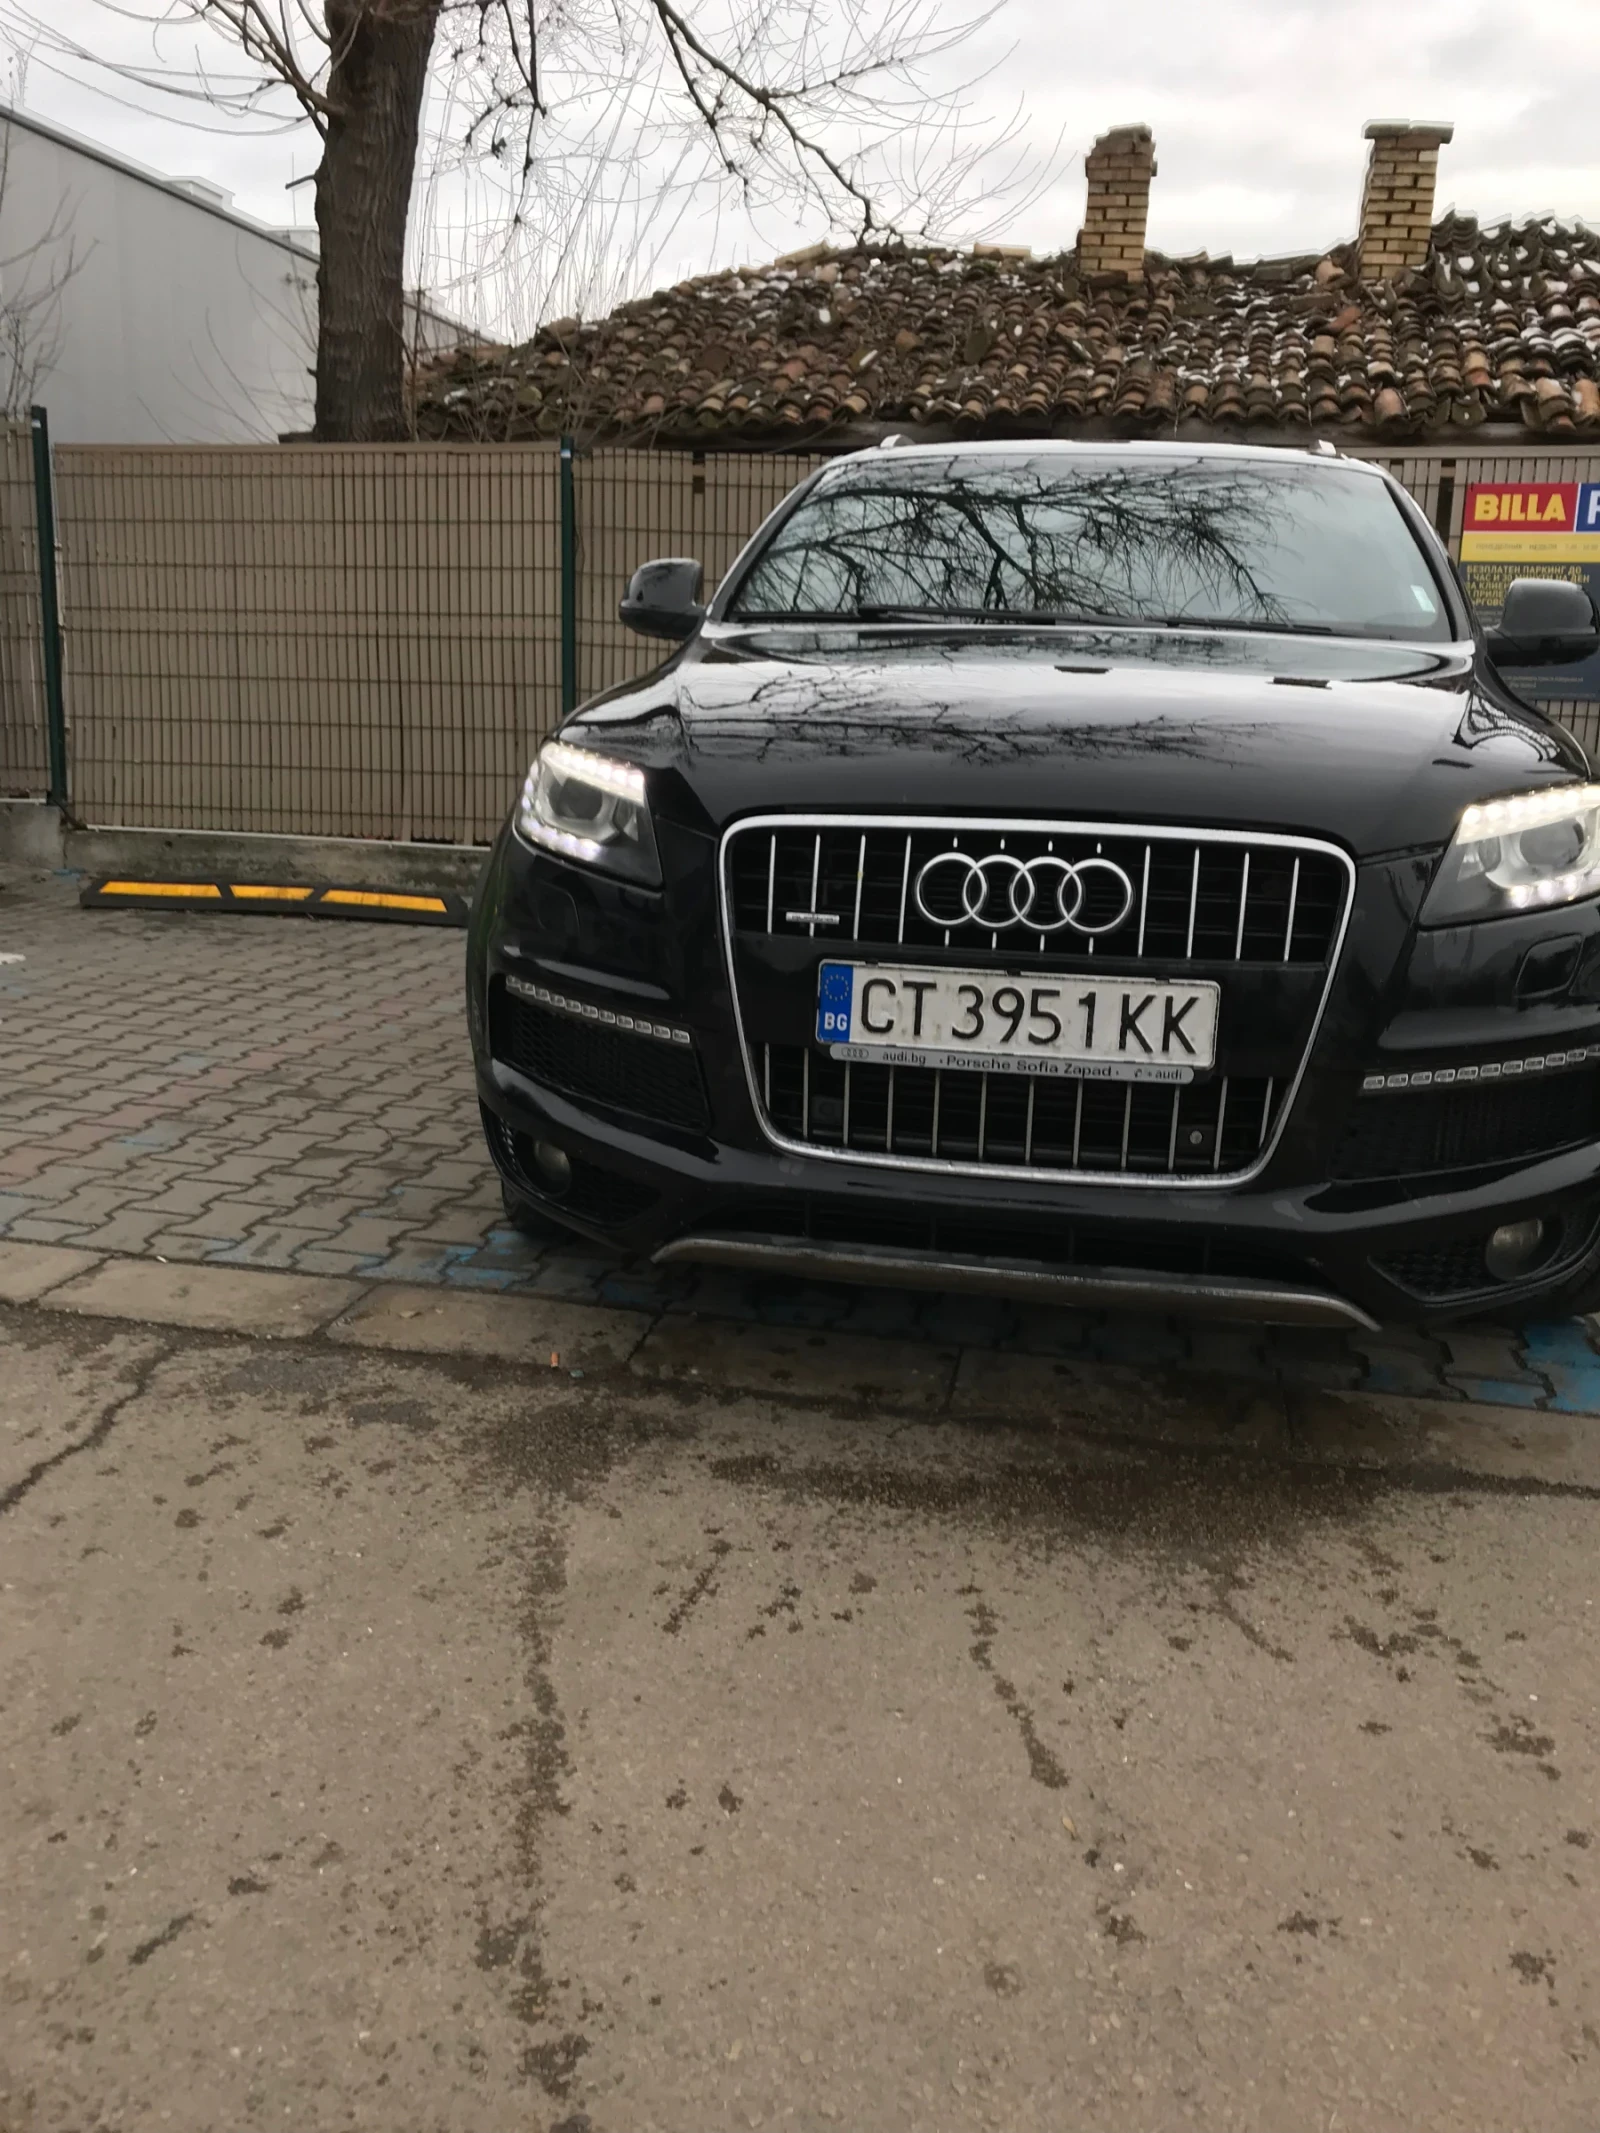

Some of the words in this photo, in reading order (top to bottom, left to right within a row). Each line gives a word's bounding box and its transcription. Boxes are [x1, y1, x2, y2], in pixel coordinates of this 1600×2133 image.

[1474, 493, 1566, 521] BILLA
[1466, 565, 1520, 574] БЕЗПЛАТЕН
[1523, 565, 1567, 575] ПАРКИНГ
[1567, 566, 1582, 576] ДО
[1473, 573, 1491, 582] ЧАС
[824, 1012, 848, 1031] BG
[861, 978, 938, 1036] CT
[952, 984, 1097, 1049] 3951
[1119, 993, 1200, 1055] KK
[882, 1051, 926, 1067] audi.bg
[946, 1055, 1011, 1071] Porsche
[1016, 1059, 1059, 1074] Sofia
[1063, 1062, 1112, 1079] Zapad
